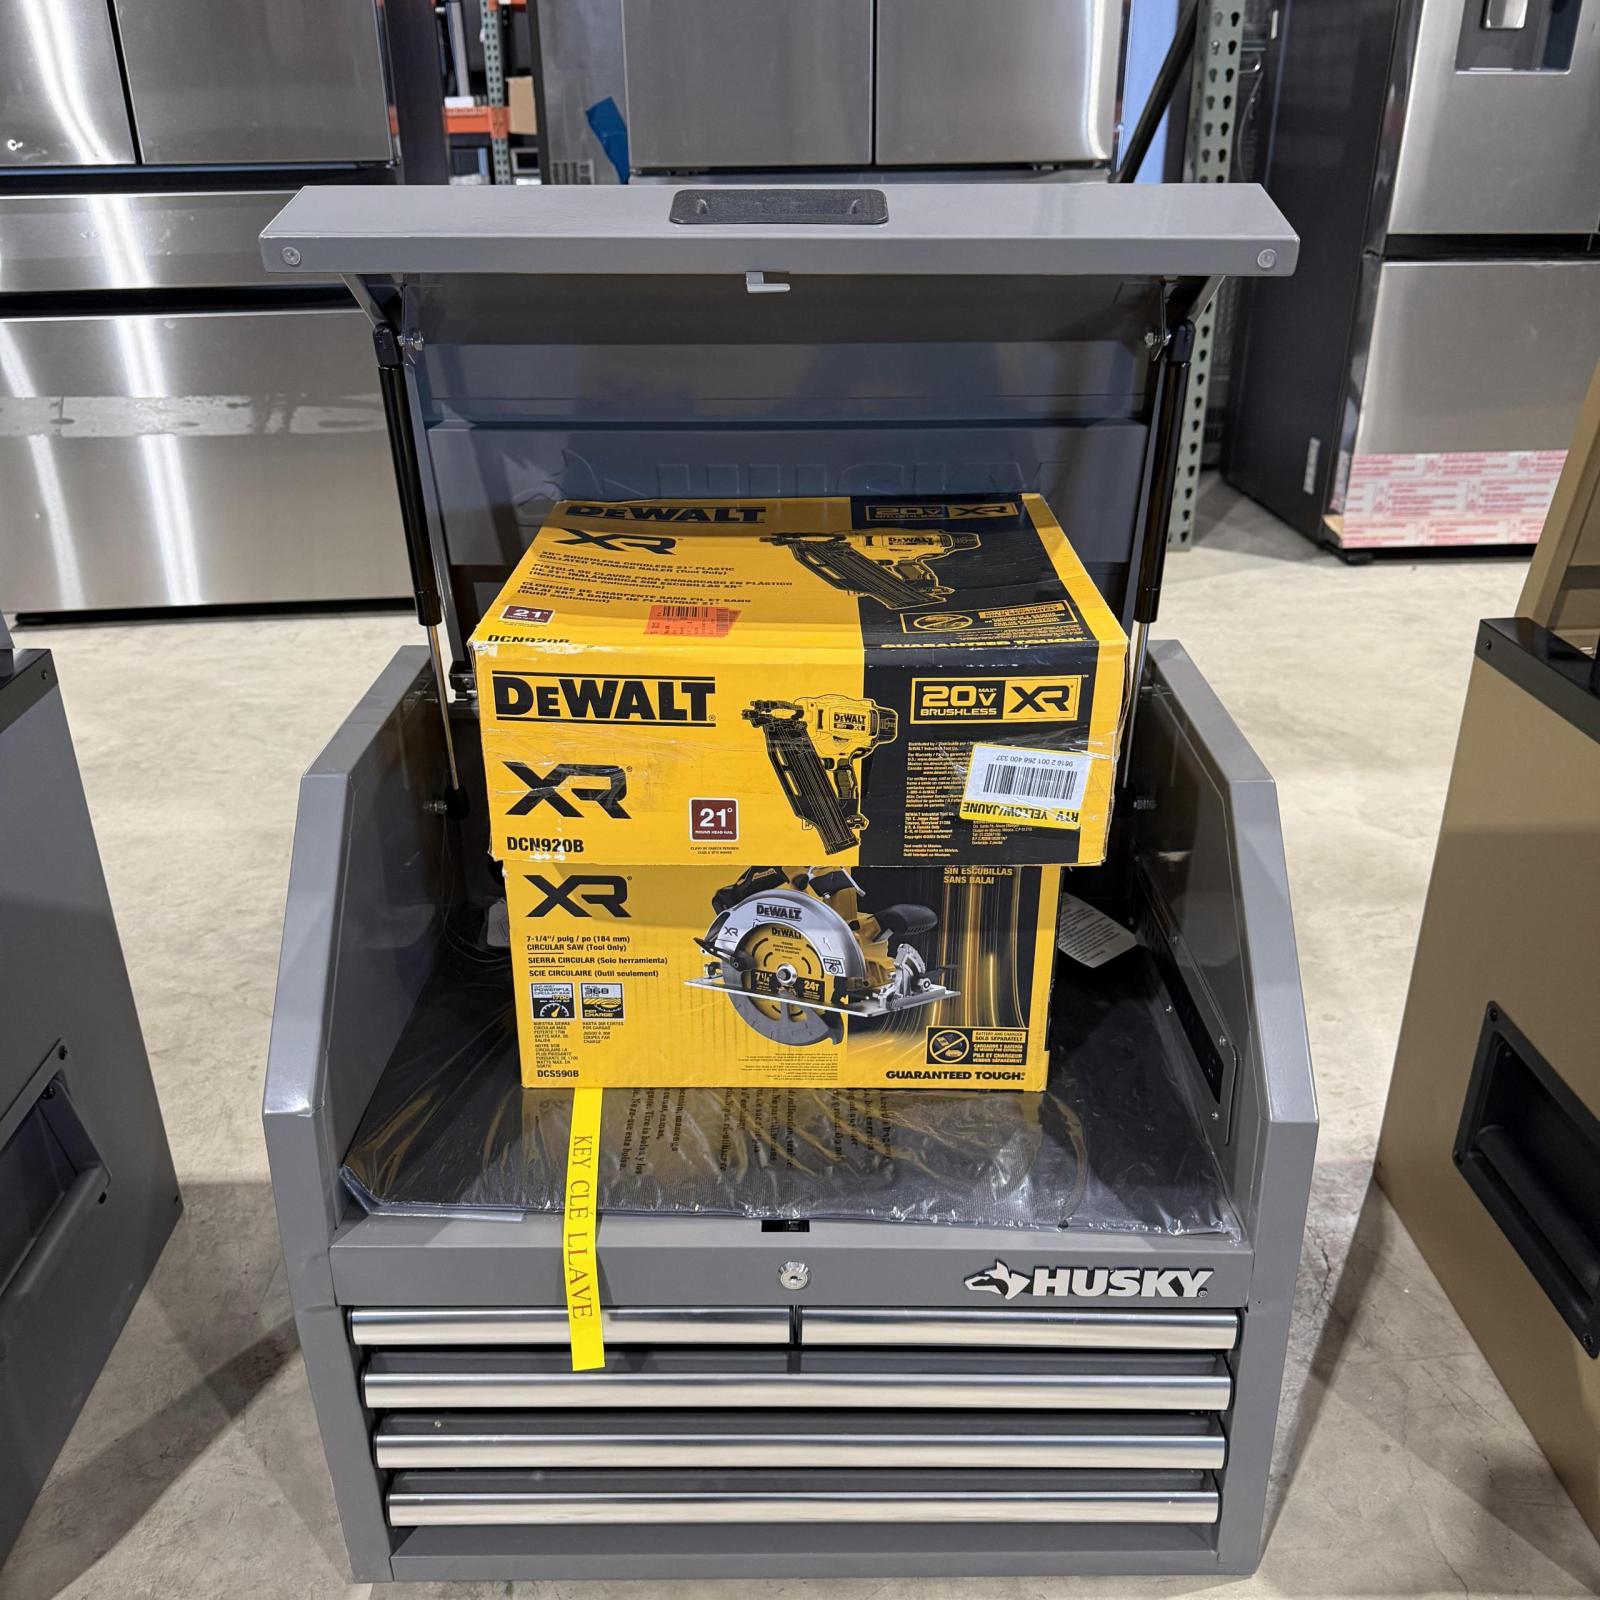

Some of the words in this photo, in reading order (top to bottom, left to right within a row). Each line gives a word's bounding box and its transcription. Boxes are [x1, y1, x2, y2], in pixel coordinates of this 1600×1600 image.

[566, 506, 766, 522] DEWALT
[956, 506, 1008, 516] XR
[554, 528, 677, 555] XR
[492, 676, 715, 721] DEWALT
[1008, 685, 1072, 713] XR
[834, 712, 866, 724] DEWALT
[920, 708, 997, 716] BRUSHLESS
[502, 760, 632, 819] XR
[506, 836, 584, 853] DCN920B
[962, 867, 1013, 876] ESCOBILLAS
[969, 876, 994, 884] BALAI
[523, 875, 632, 917] XR
[756, 904, 802, 920] DEWALT
[724, 926, 738, 936] XR
[557, 936, 574, 944] pulg
[619, 957, 668, 965] herramienta)
[803, 980, 820, 991] 24T
[886, 1071, 972, 1079] GUARANTEED
[624, 1132, 632, 1146] esta
[572, 1135, 592, 1168] KEY
[569, 1180, 594, 1220] CLÉ
[567, 1232, 592, 1318] LLAVE
[1032, 1266, 1214, 1298] HUSKY
